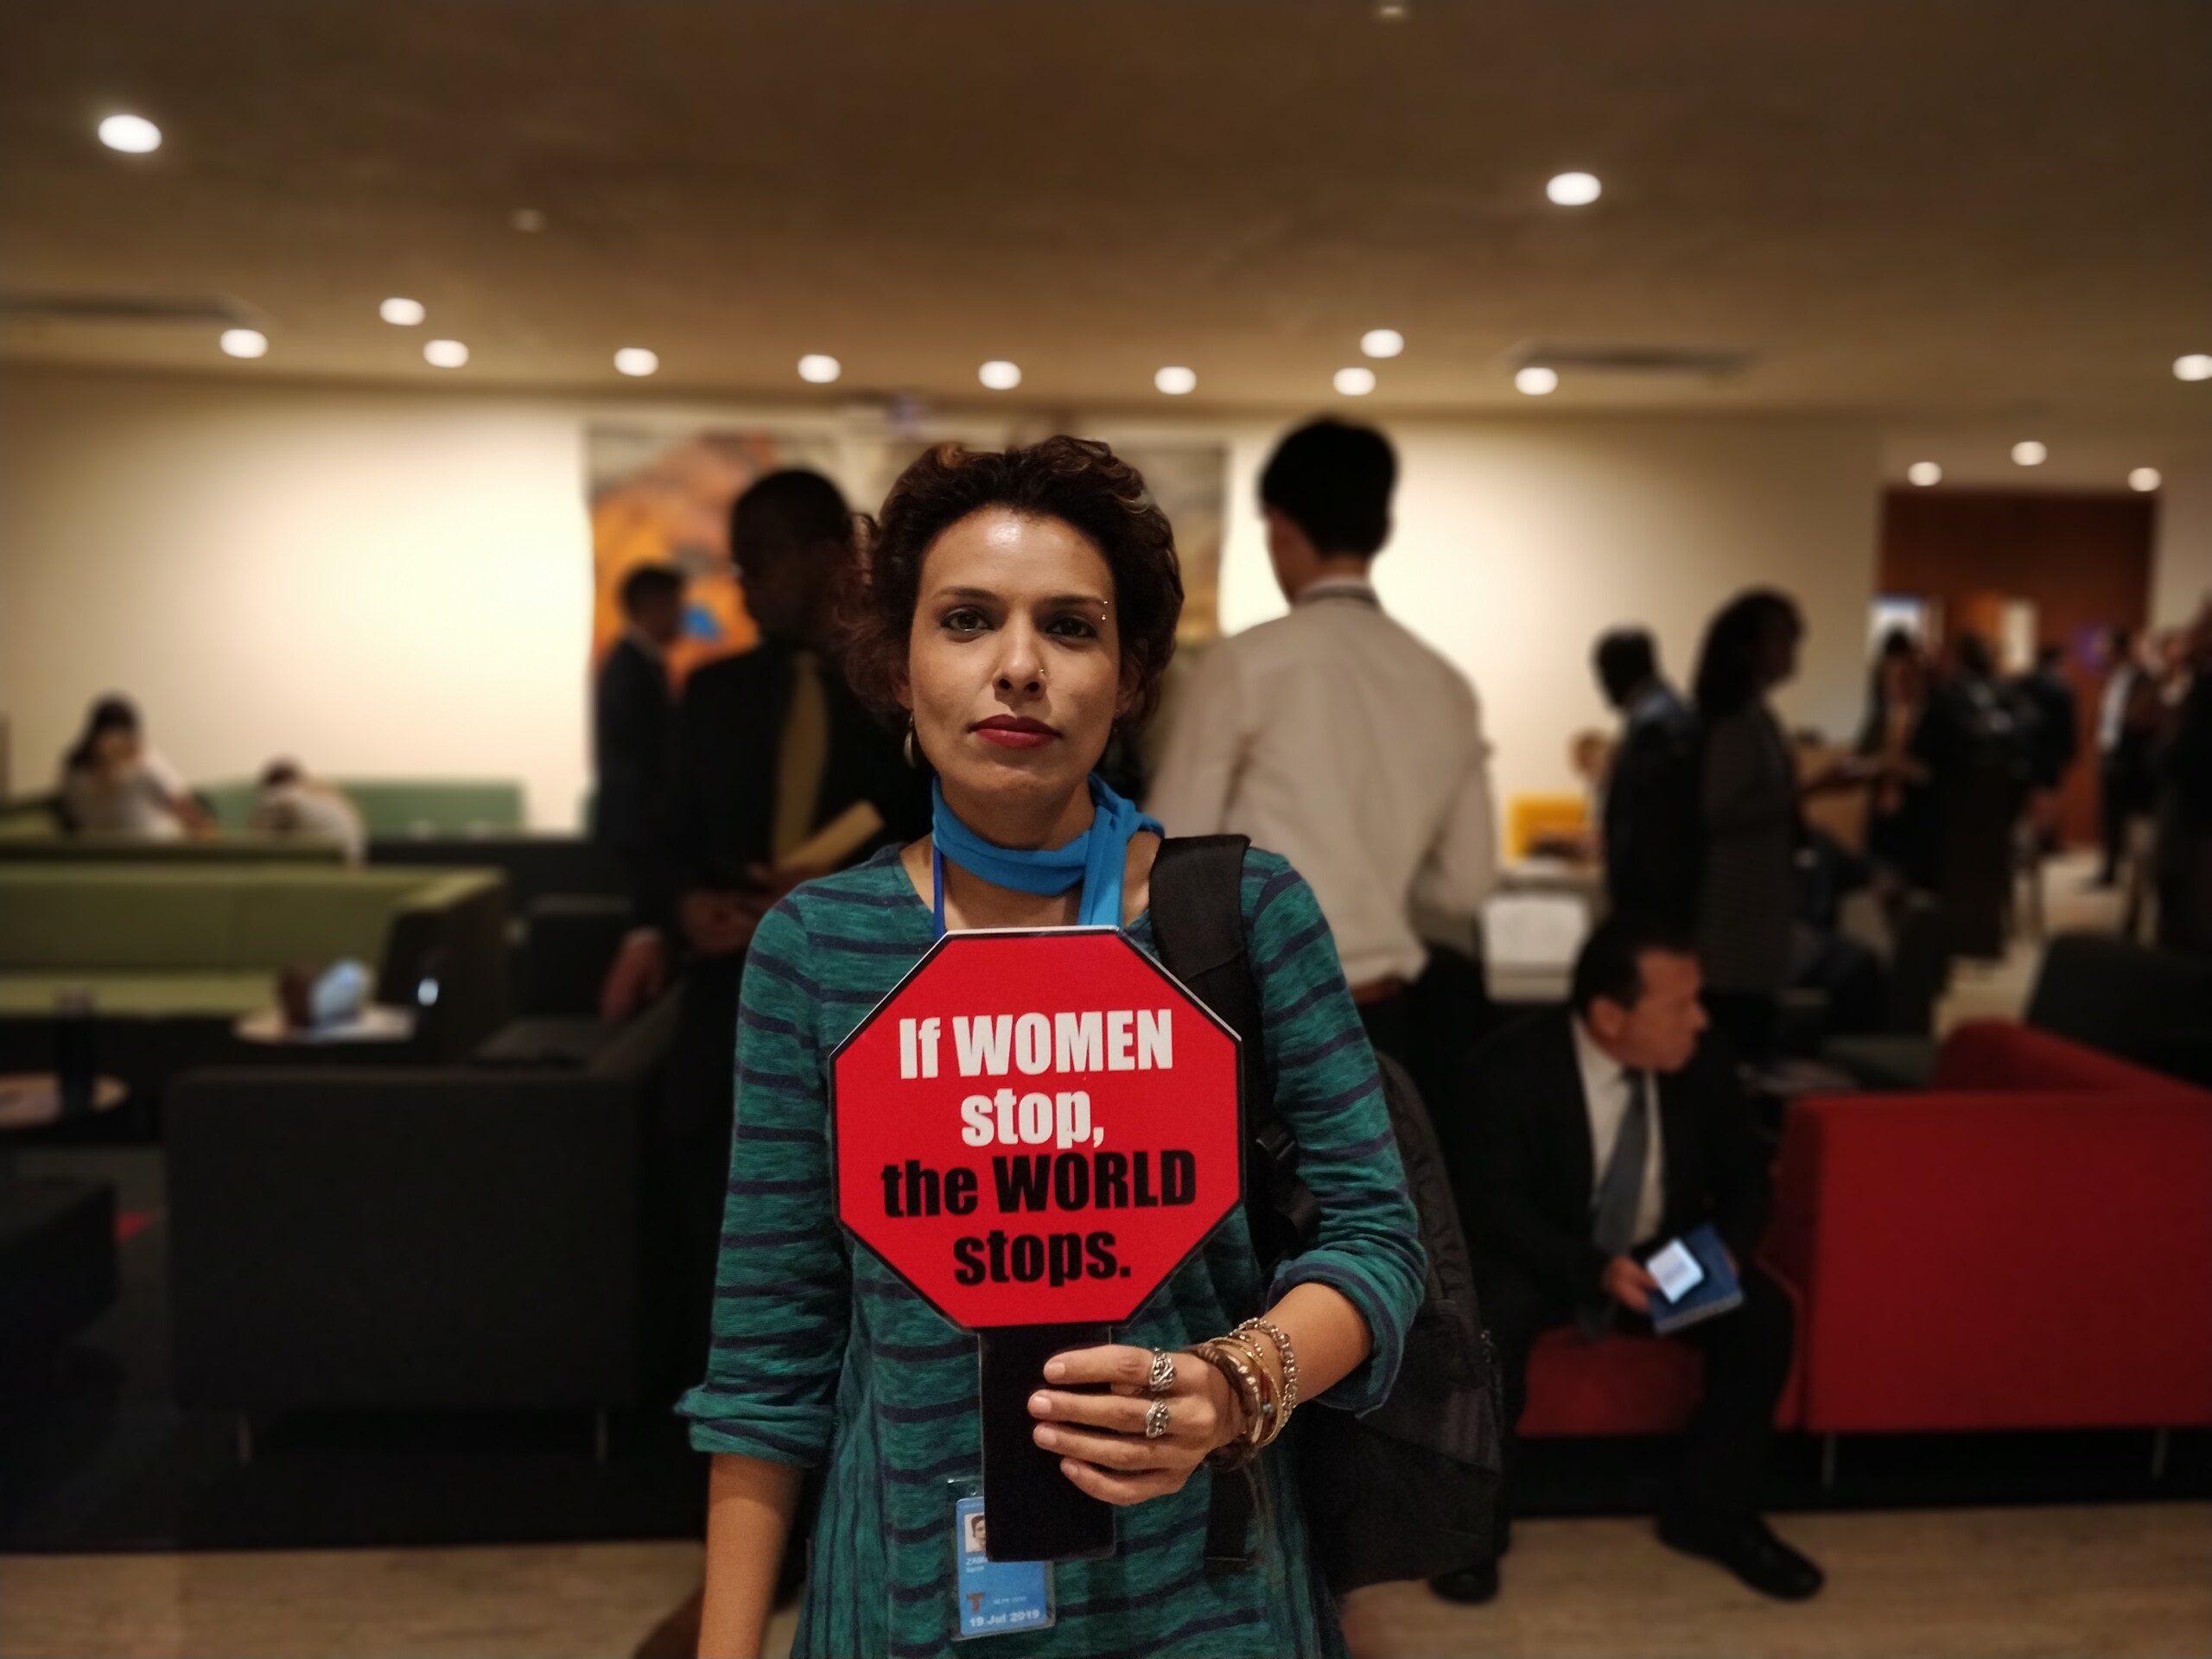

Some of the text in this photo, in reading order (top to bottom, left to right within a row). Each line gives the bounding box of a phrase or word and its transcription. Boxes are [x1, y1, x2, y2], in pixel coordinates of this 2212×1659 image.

[899, 1008, 1173, 1079] If WOMEN
[960, 1088, 1104, 1149] stop,
[881, 1149, 1196, 1217] the WORLD
[953, 1230, 1131, 1288] stops.
[969, 1610, 1039, 1627] 19 Jul 2019
